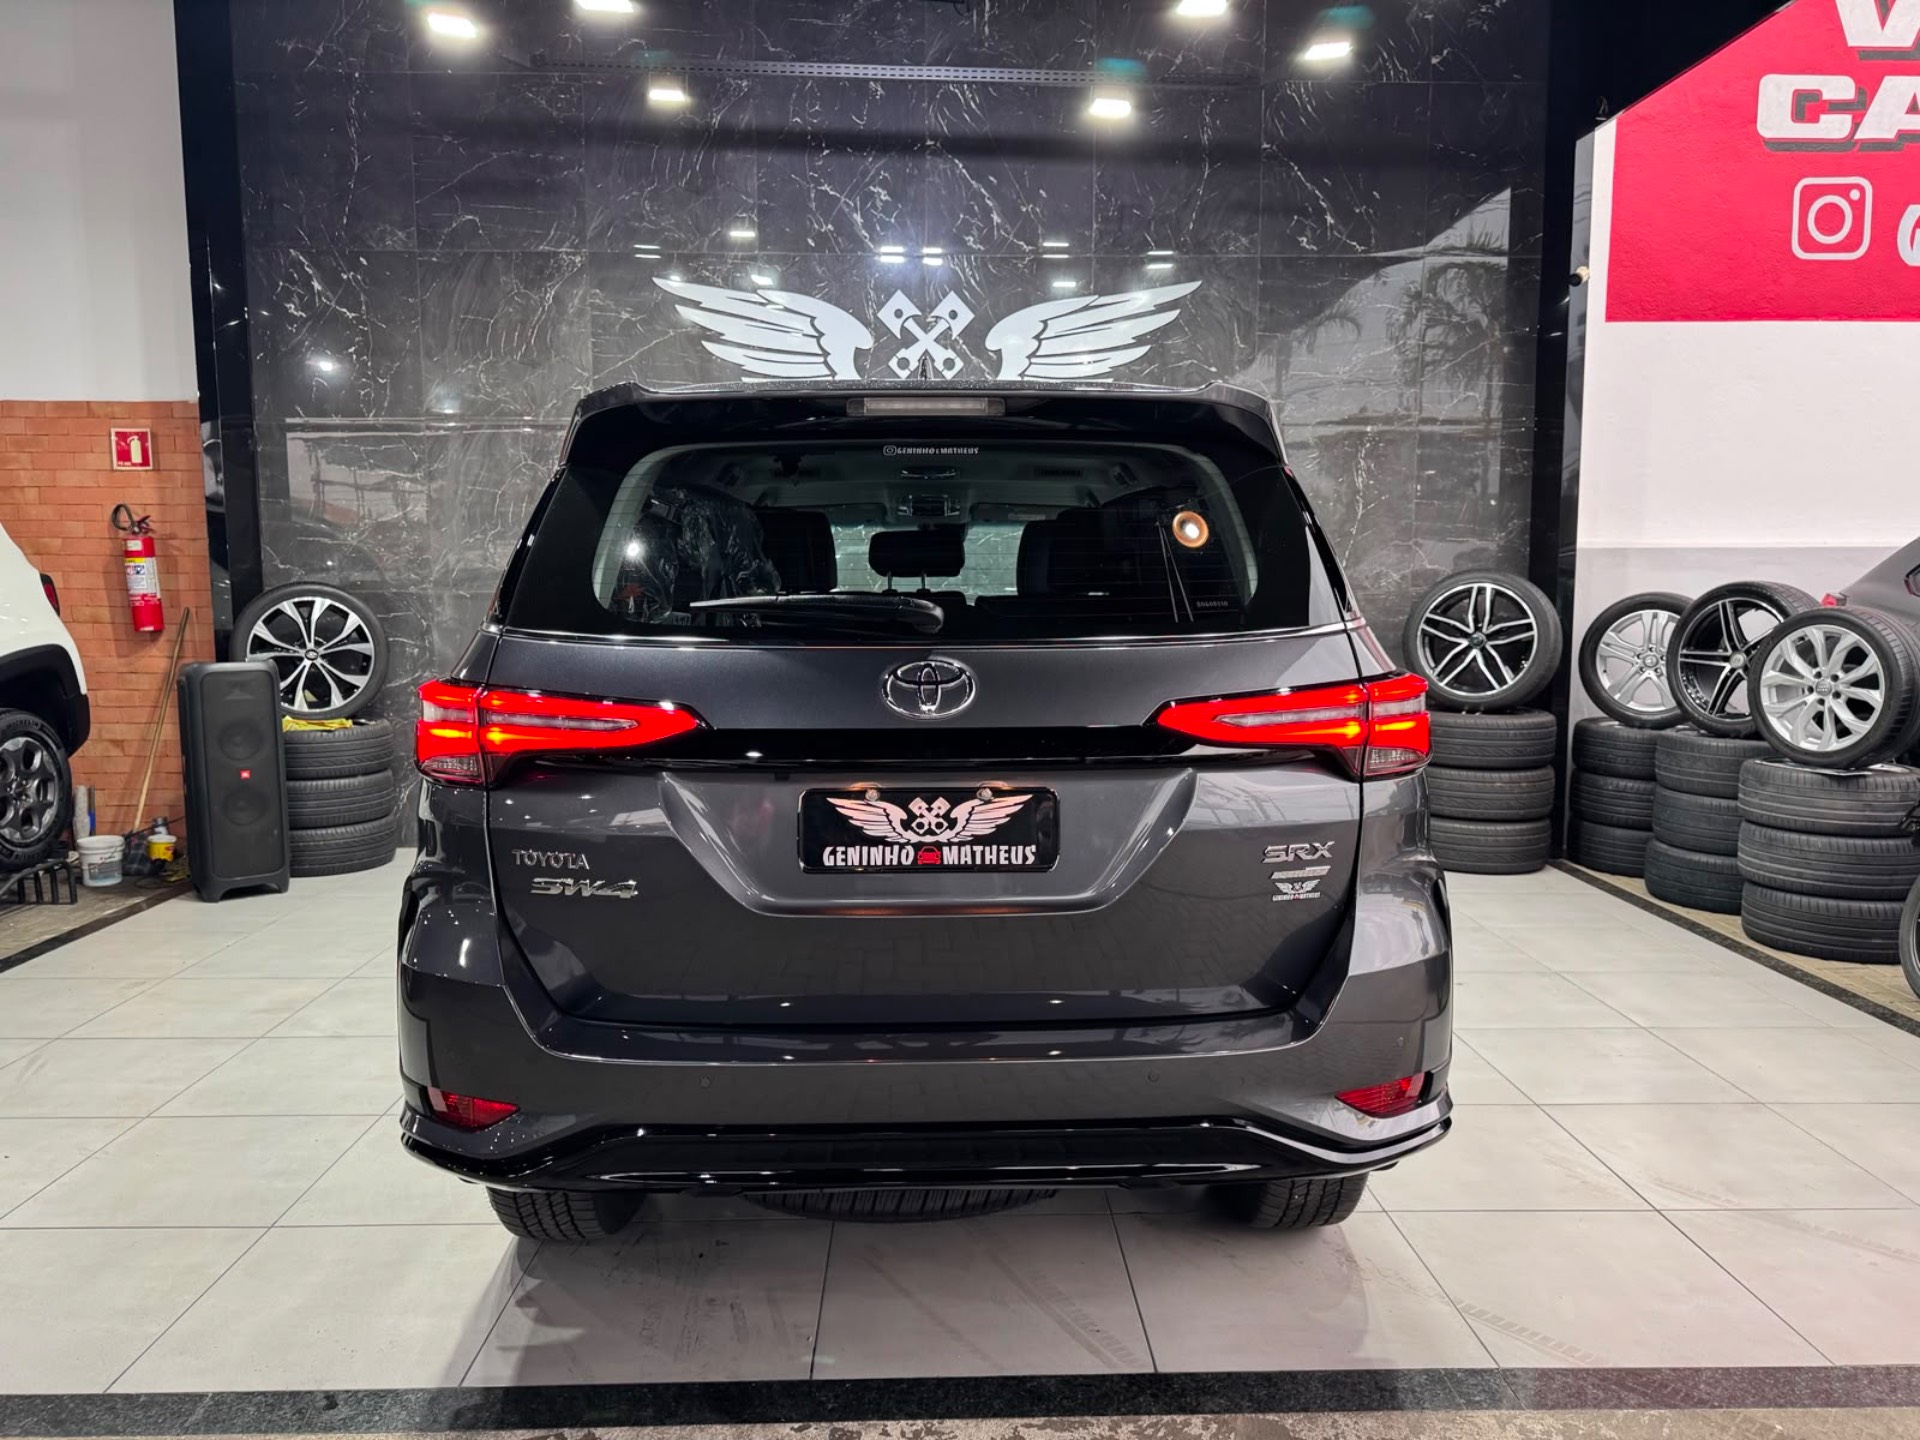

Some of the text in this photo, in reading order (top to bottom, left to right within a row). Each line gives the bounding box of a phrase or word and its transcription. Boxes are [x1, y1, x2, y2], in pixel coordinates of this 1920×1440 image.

[512, 849, 590, 870] TOYOTA
[823, 844, 1036, 866] GENINHO MATHEUS
[1262, 841, 1335, 863] SRX
[530, 877, 639, 898] SW4
